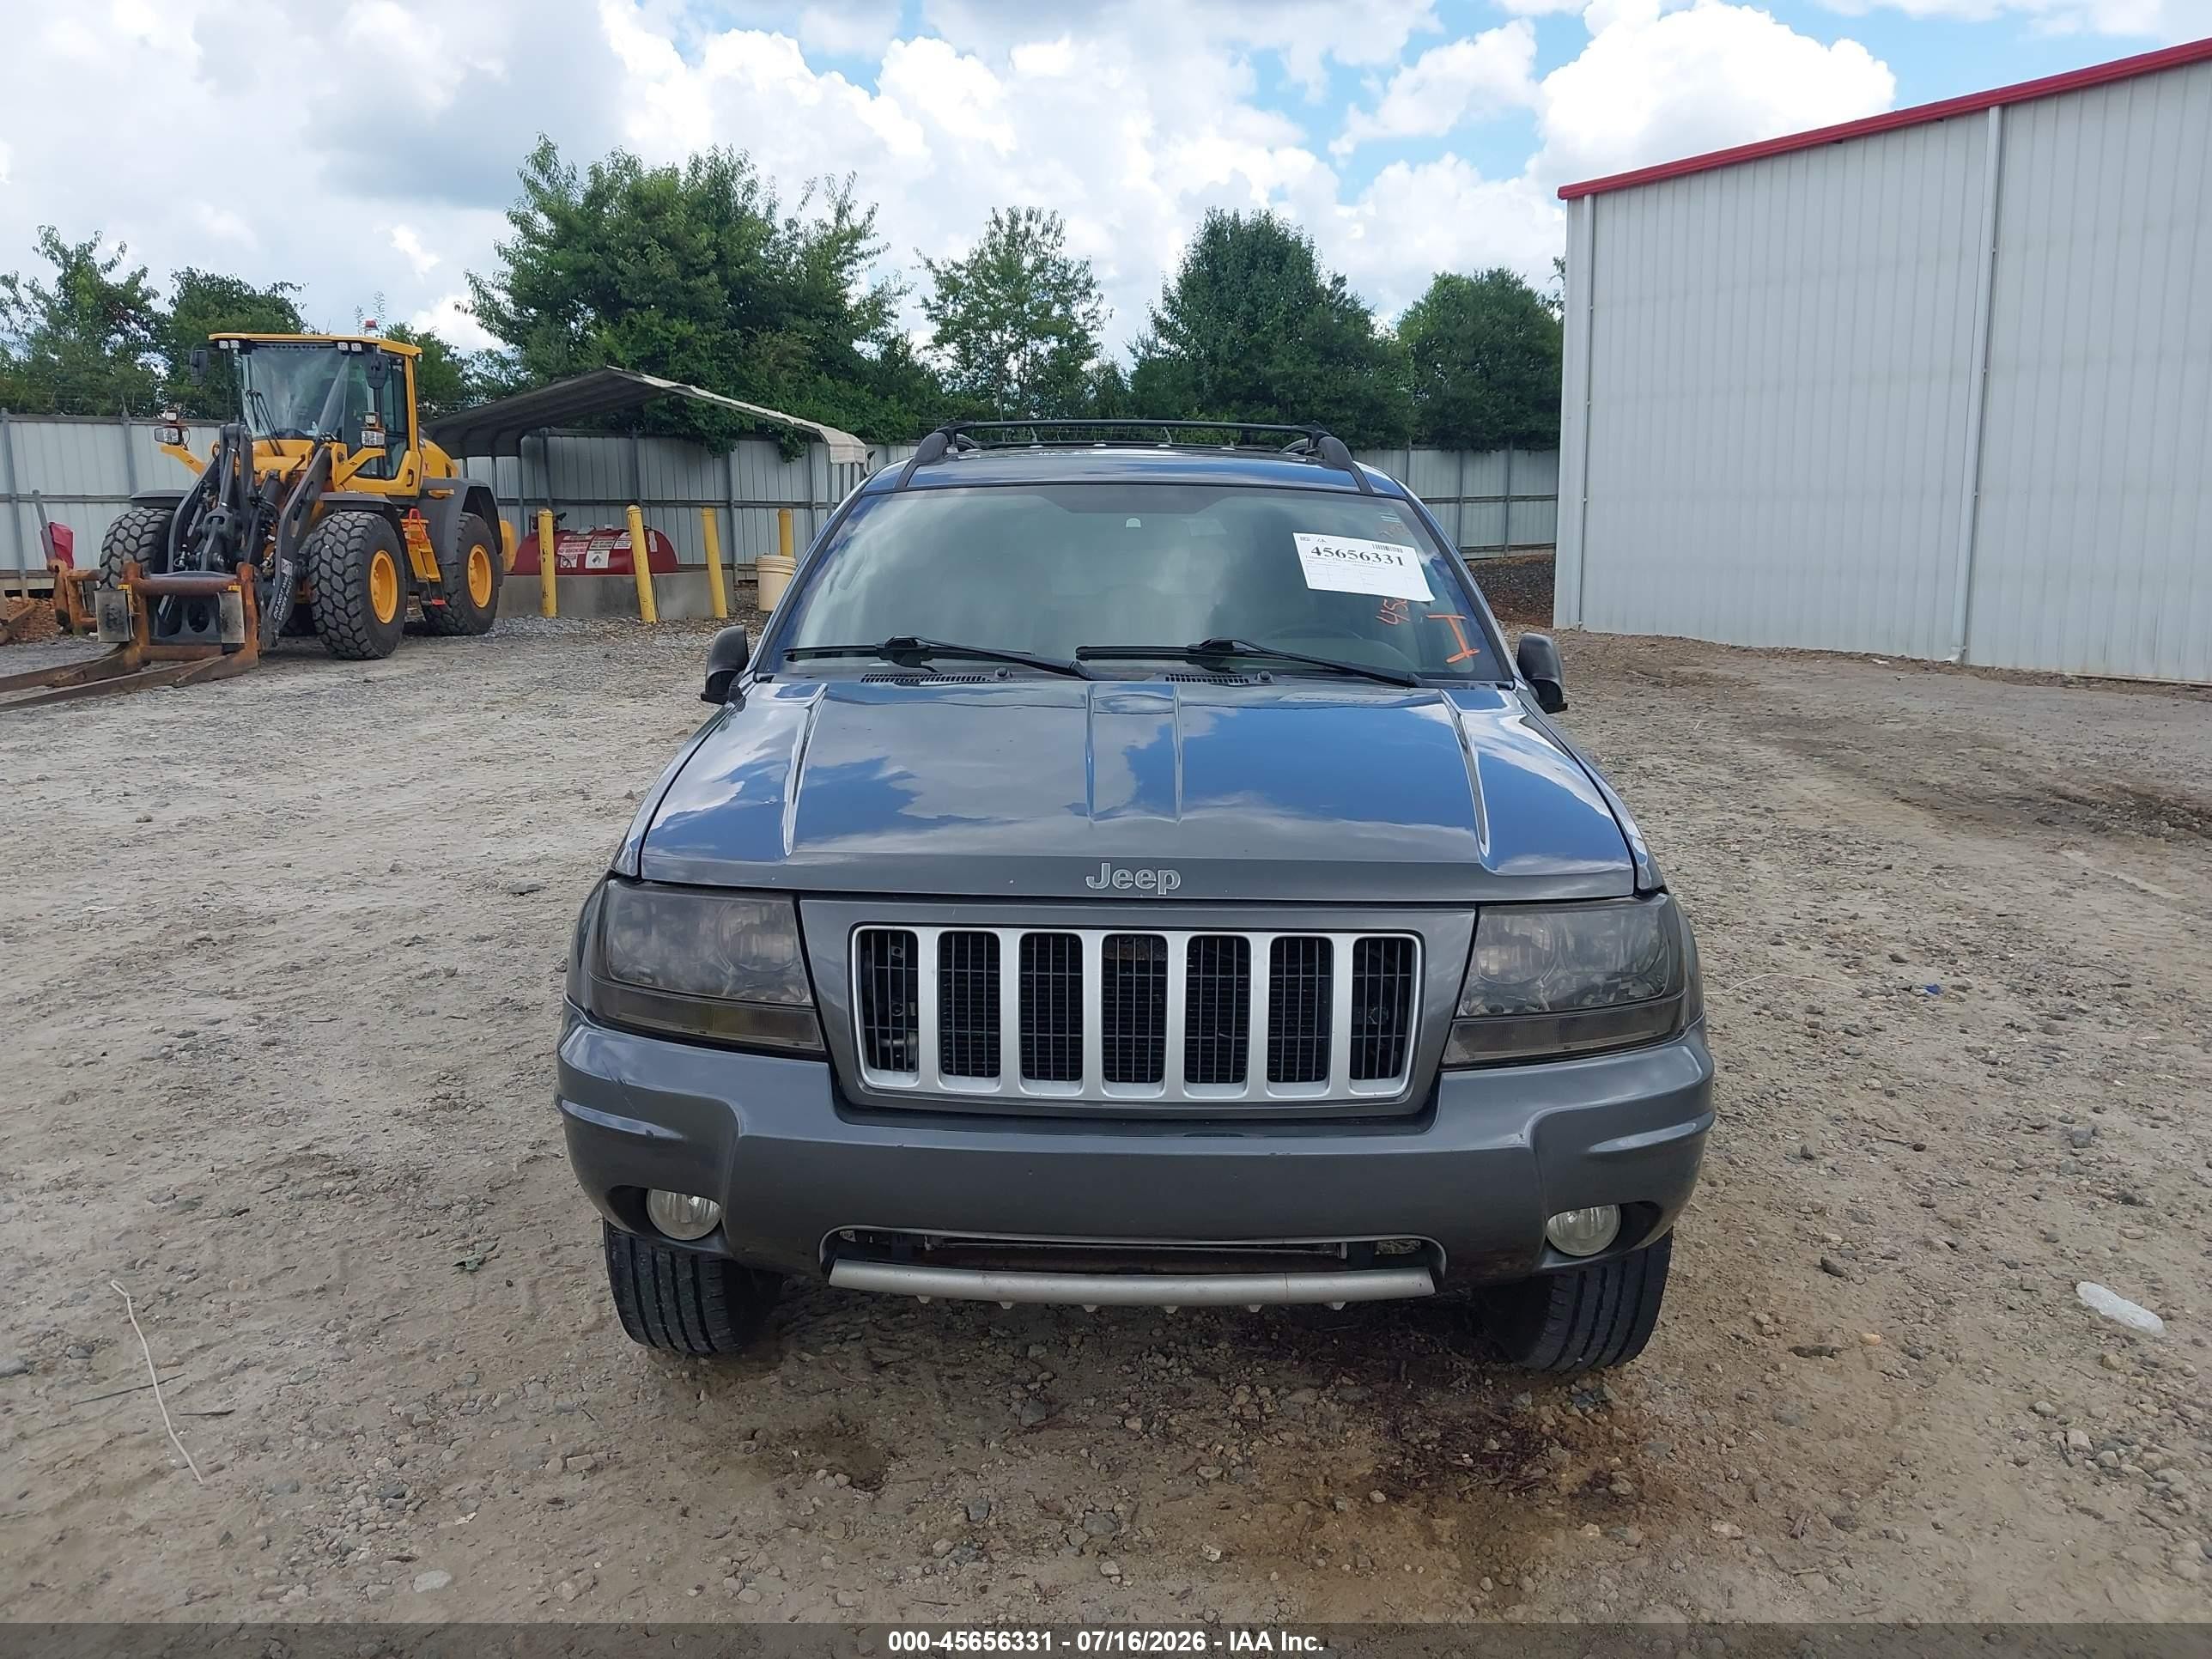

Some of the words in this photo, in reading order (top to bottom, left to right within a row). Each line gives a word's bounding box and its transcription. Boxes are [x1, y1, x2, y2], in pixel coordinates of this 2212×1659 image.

[1310, 546, 1406, 567] 45656331
[273, 605, 279, 619] DO
[1085, 862, 1182, 896] Jeep
